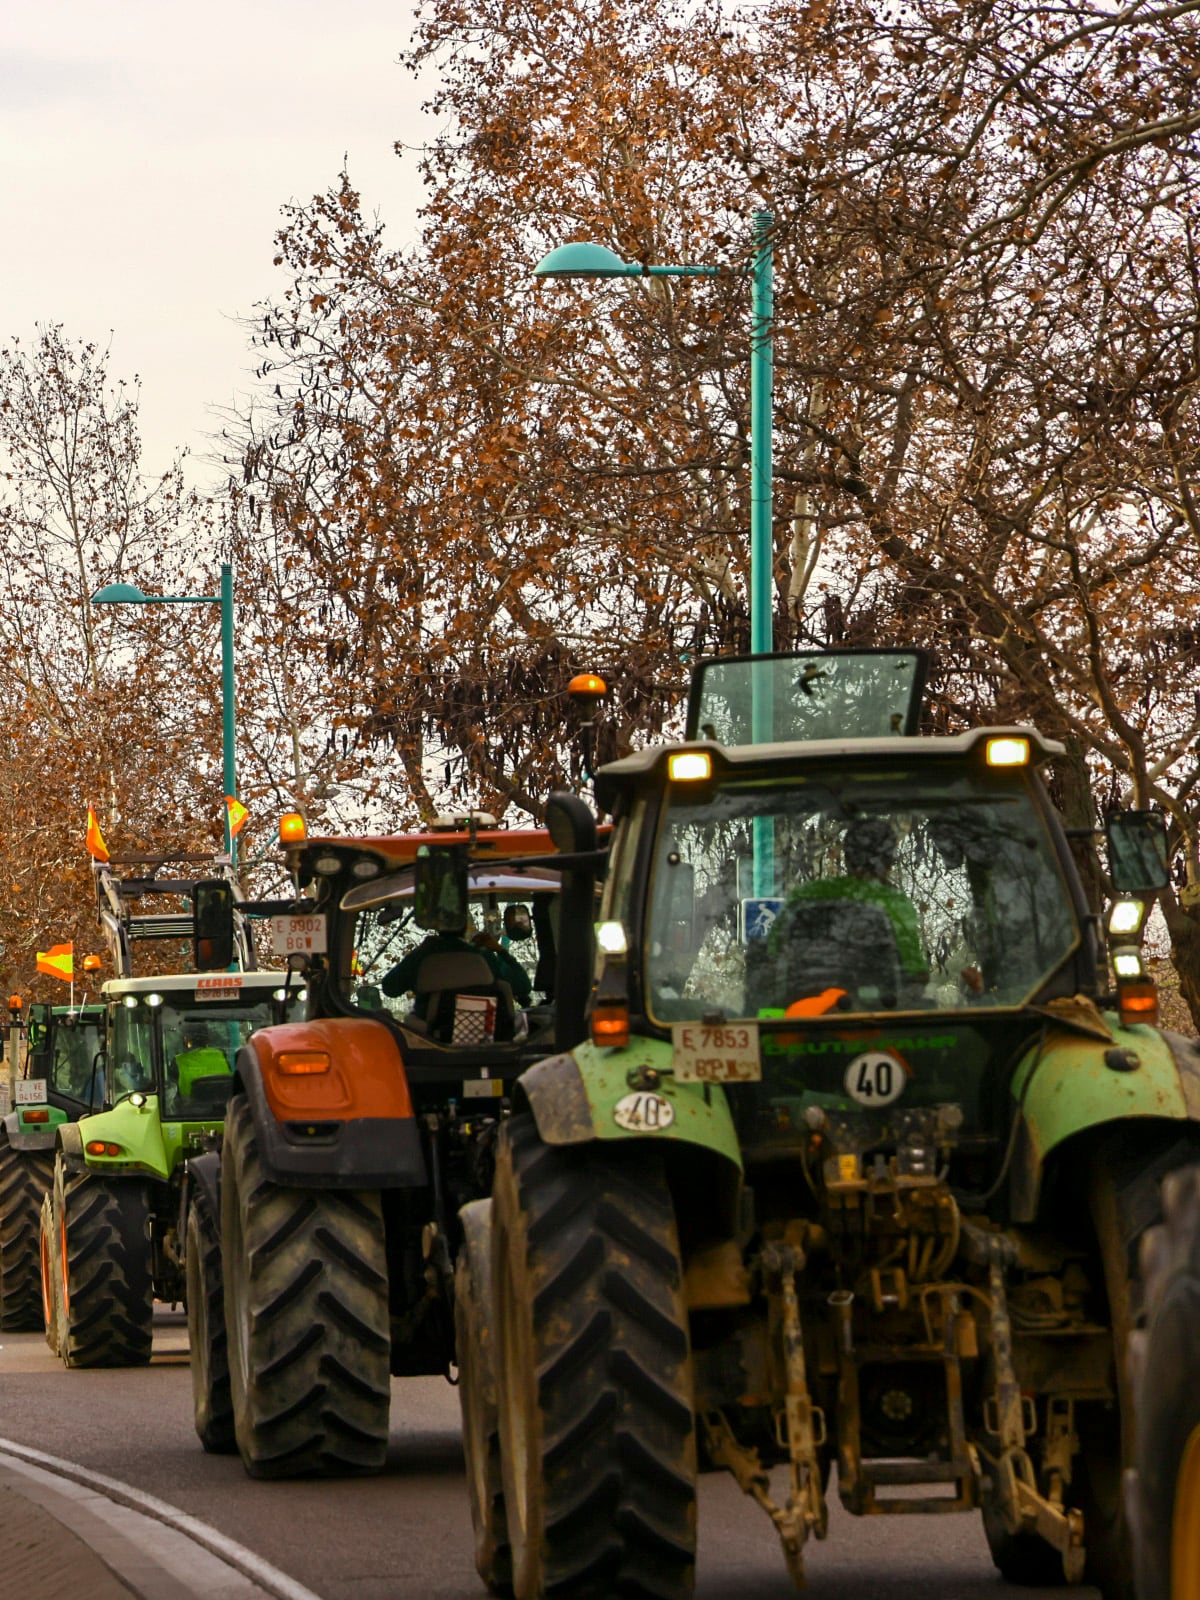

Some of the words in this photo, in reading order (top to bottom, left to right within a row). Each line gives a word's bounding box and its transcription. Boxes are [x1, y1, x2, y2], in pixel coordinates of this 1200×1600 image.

[276, 920, 285, 933] E
[289, 918, 321, 933] 9902
[197, 977, 243, 989] CLAAS
[682, 1029, 695, 1047] E
[700, 1028, 749, 1047] 7853
[855, 1062, 893, 1097] 40
[628, 1095, 660, 1126] 40
